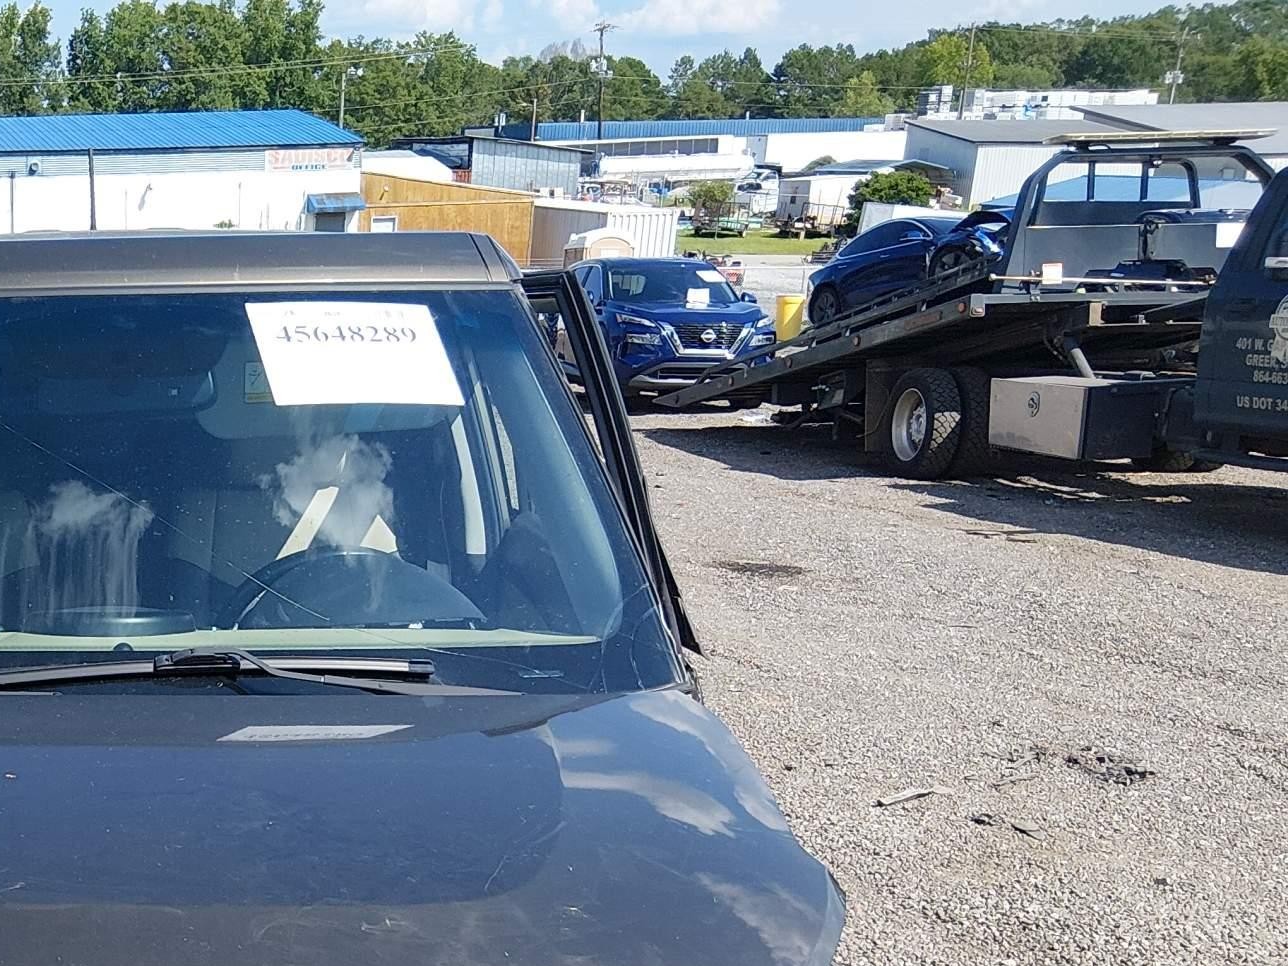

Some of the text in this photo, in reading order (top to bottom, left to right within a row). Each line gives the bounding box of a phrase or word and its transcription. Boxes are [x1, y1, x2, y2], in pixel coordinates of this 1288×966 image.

[276, 325, 417, 343] 45648289
[1235, 337, 1252, 350] 401
[1236, 395, 1250, 408] US
[1253, 397, 1273, 410] DOT
